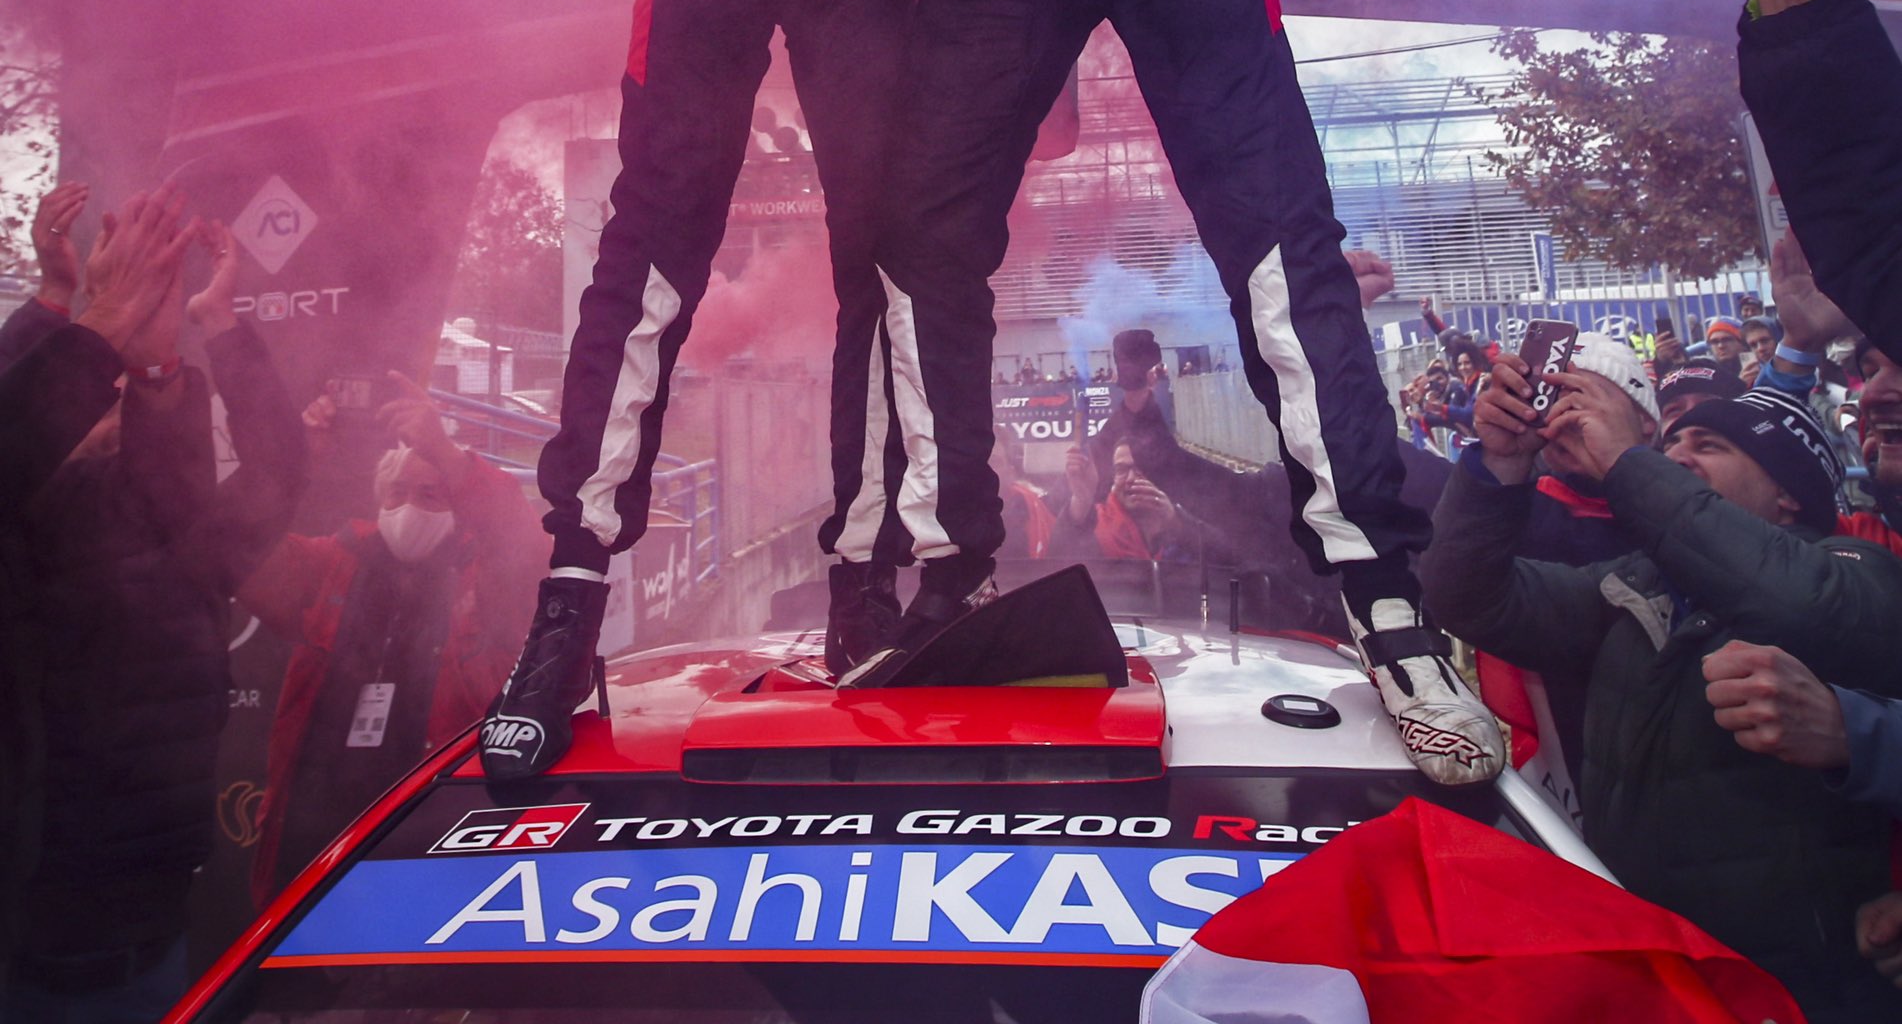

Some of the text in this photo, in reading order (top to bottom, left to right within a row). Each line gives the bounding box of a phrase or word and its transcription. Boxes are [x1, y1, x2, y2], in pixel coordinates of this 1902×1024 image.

[256, 208, 301, 240] ACI
[1011, 419, 1073, 439] YOU
[481, 721, 537, 748] OMP
[441, 809, 1362, 850] GR TOYOTA GAZOO Rac
